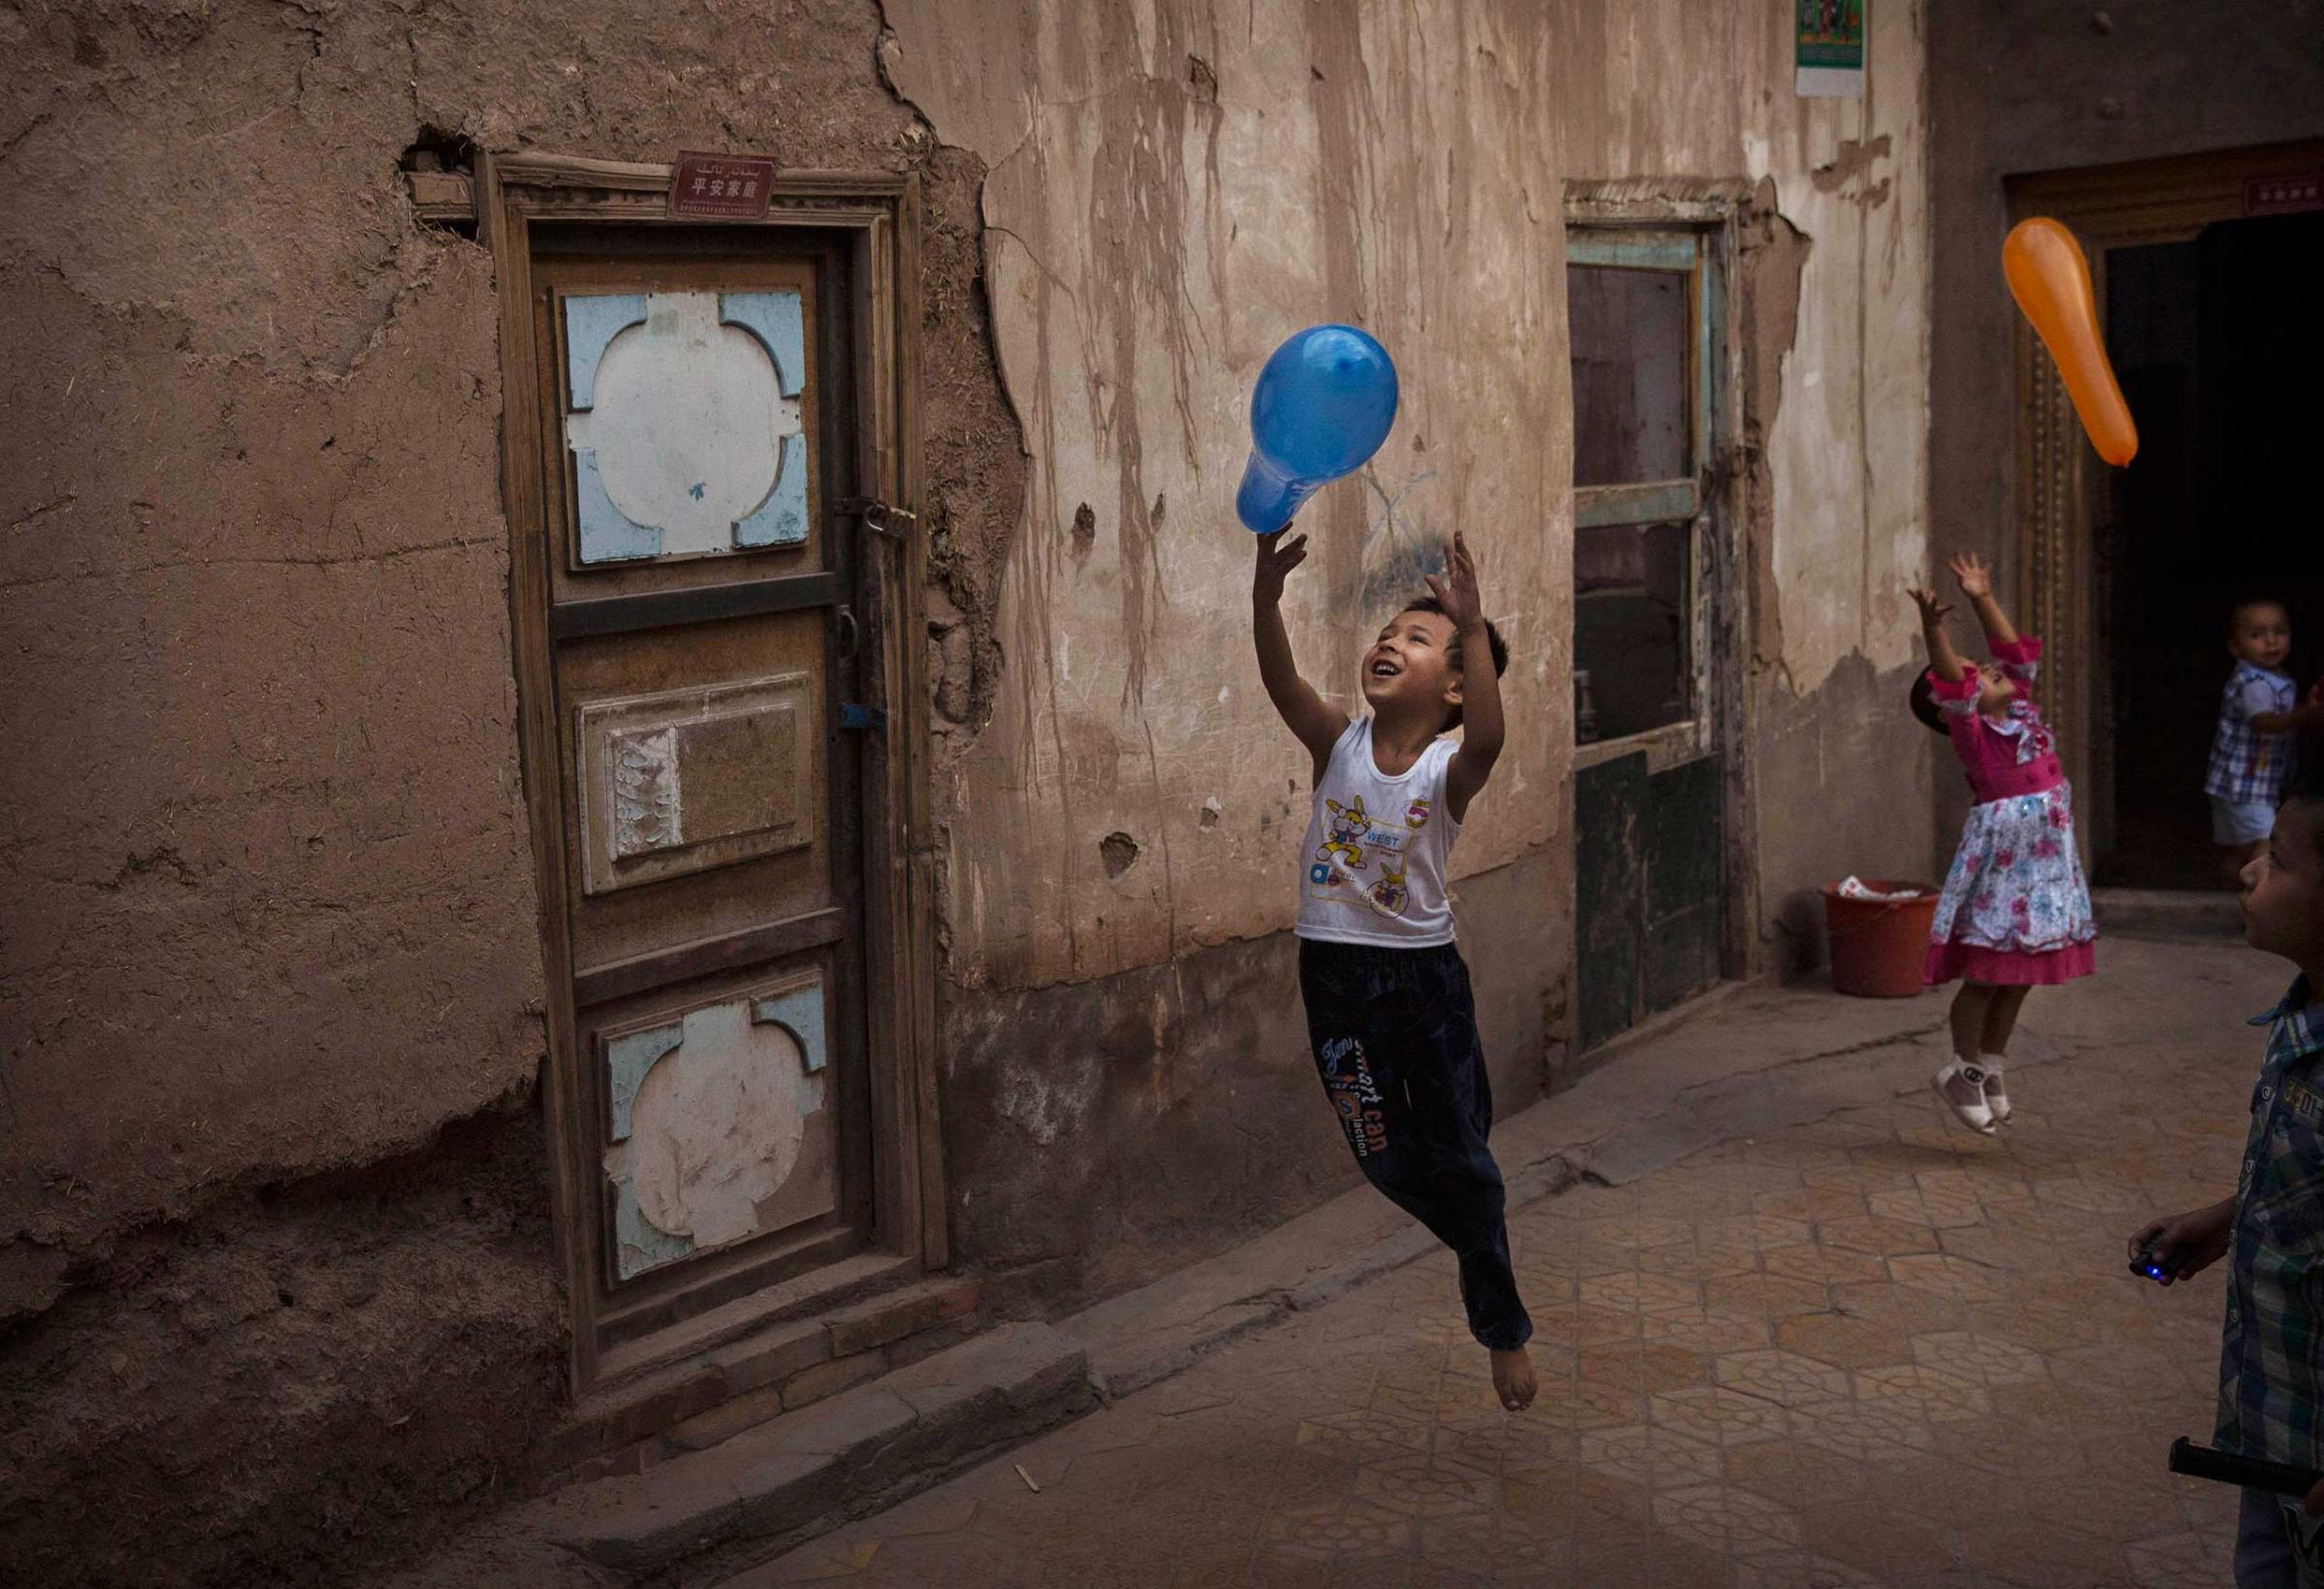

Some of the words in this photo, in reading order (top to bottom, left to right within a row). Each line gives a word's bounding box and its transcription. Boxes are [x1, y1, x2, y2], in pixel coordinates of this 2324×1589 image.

[691, 177, 758, 199] 平安家庭
[1367, 831, 1400, 847] WEST
[1363, 1109, 1388, 1152] can
